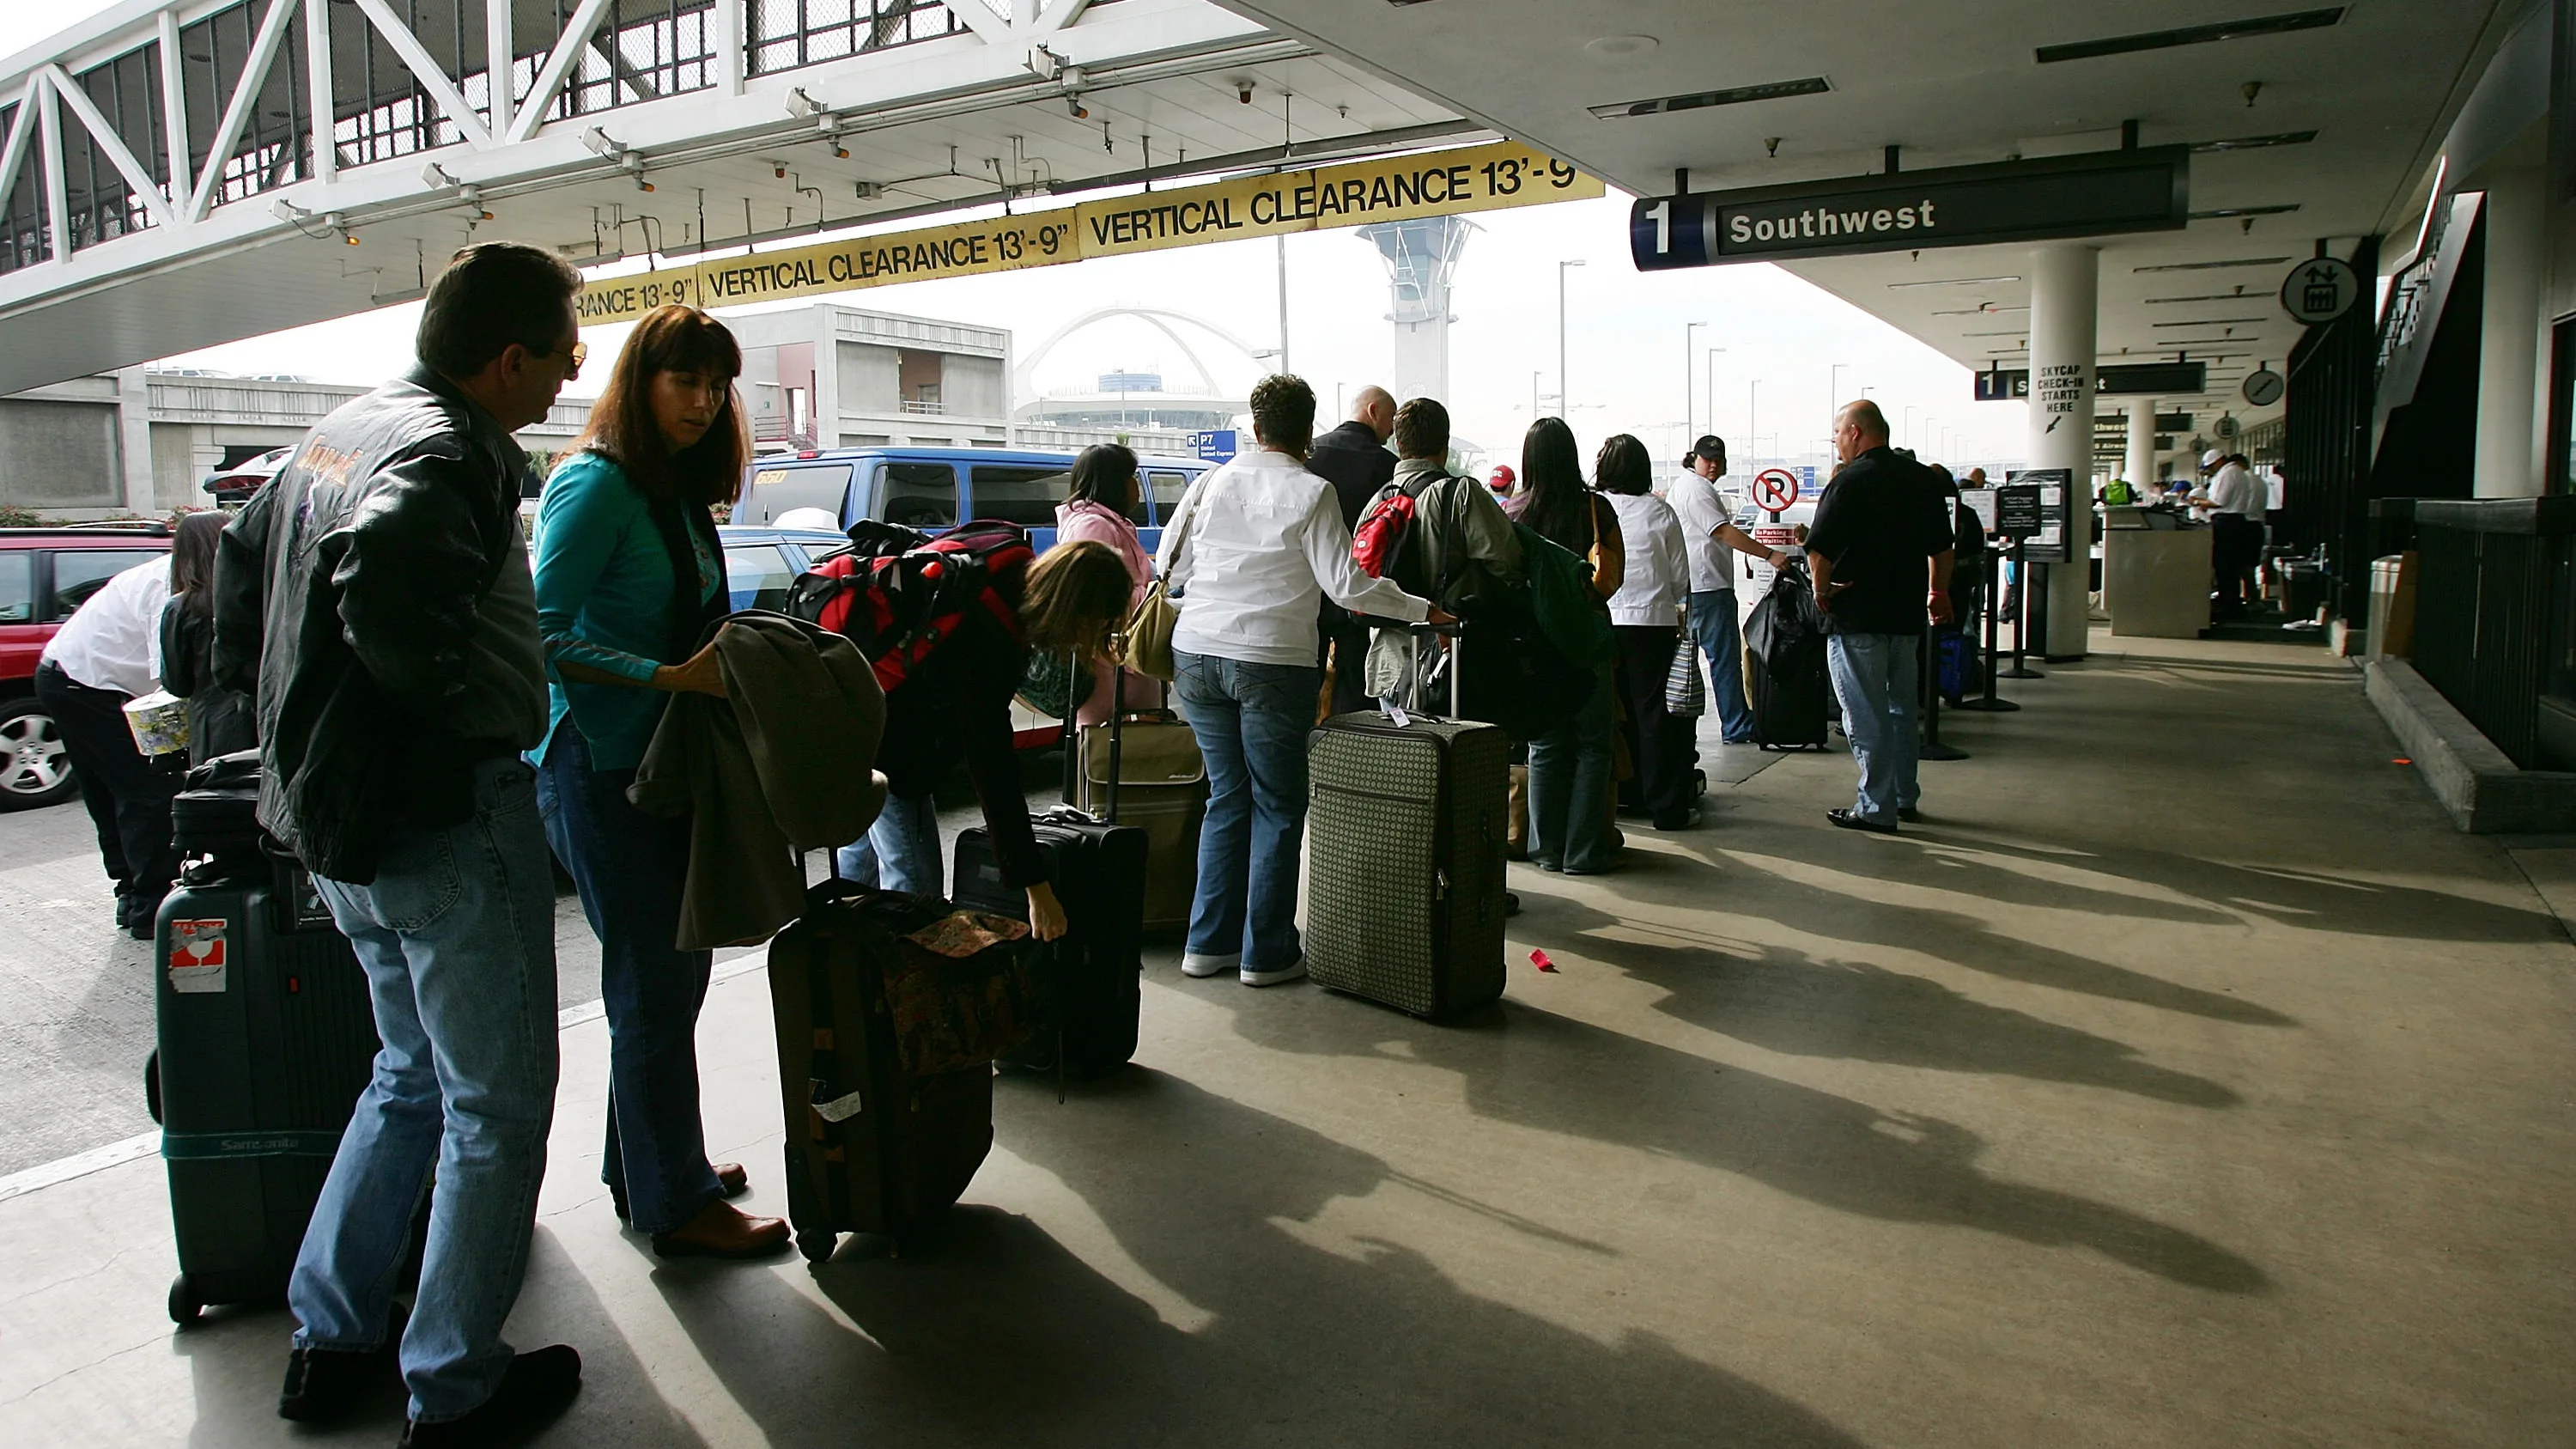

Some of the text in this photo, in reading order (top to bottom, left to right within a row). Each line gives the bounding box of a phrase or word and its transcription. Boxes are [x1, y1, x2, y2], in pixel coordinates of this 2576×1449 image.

[1090, 157, 1576, 247] VERTICAL CLEARANCE 13'-9
[1645, 198, 1935, 253] 1 Southwest
[708, 253, 825, 298] VERTICAL
[828, 234, 988, 283] CLEARANCE
[574, 287, 636, 318] RANCE
[2041, 365, 2081, 377] SKYCAP
[1982, 373, 1994, 395] 1
[2038, 378, 2084, 389] CHECK-IN
[2041, 389, 2081, 401] STARTS
[2047, 401, 2074, 412] HERE
[1200, 434, 1214, 445] P7
[220, 1138, 299, 1150] Samsonite
